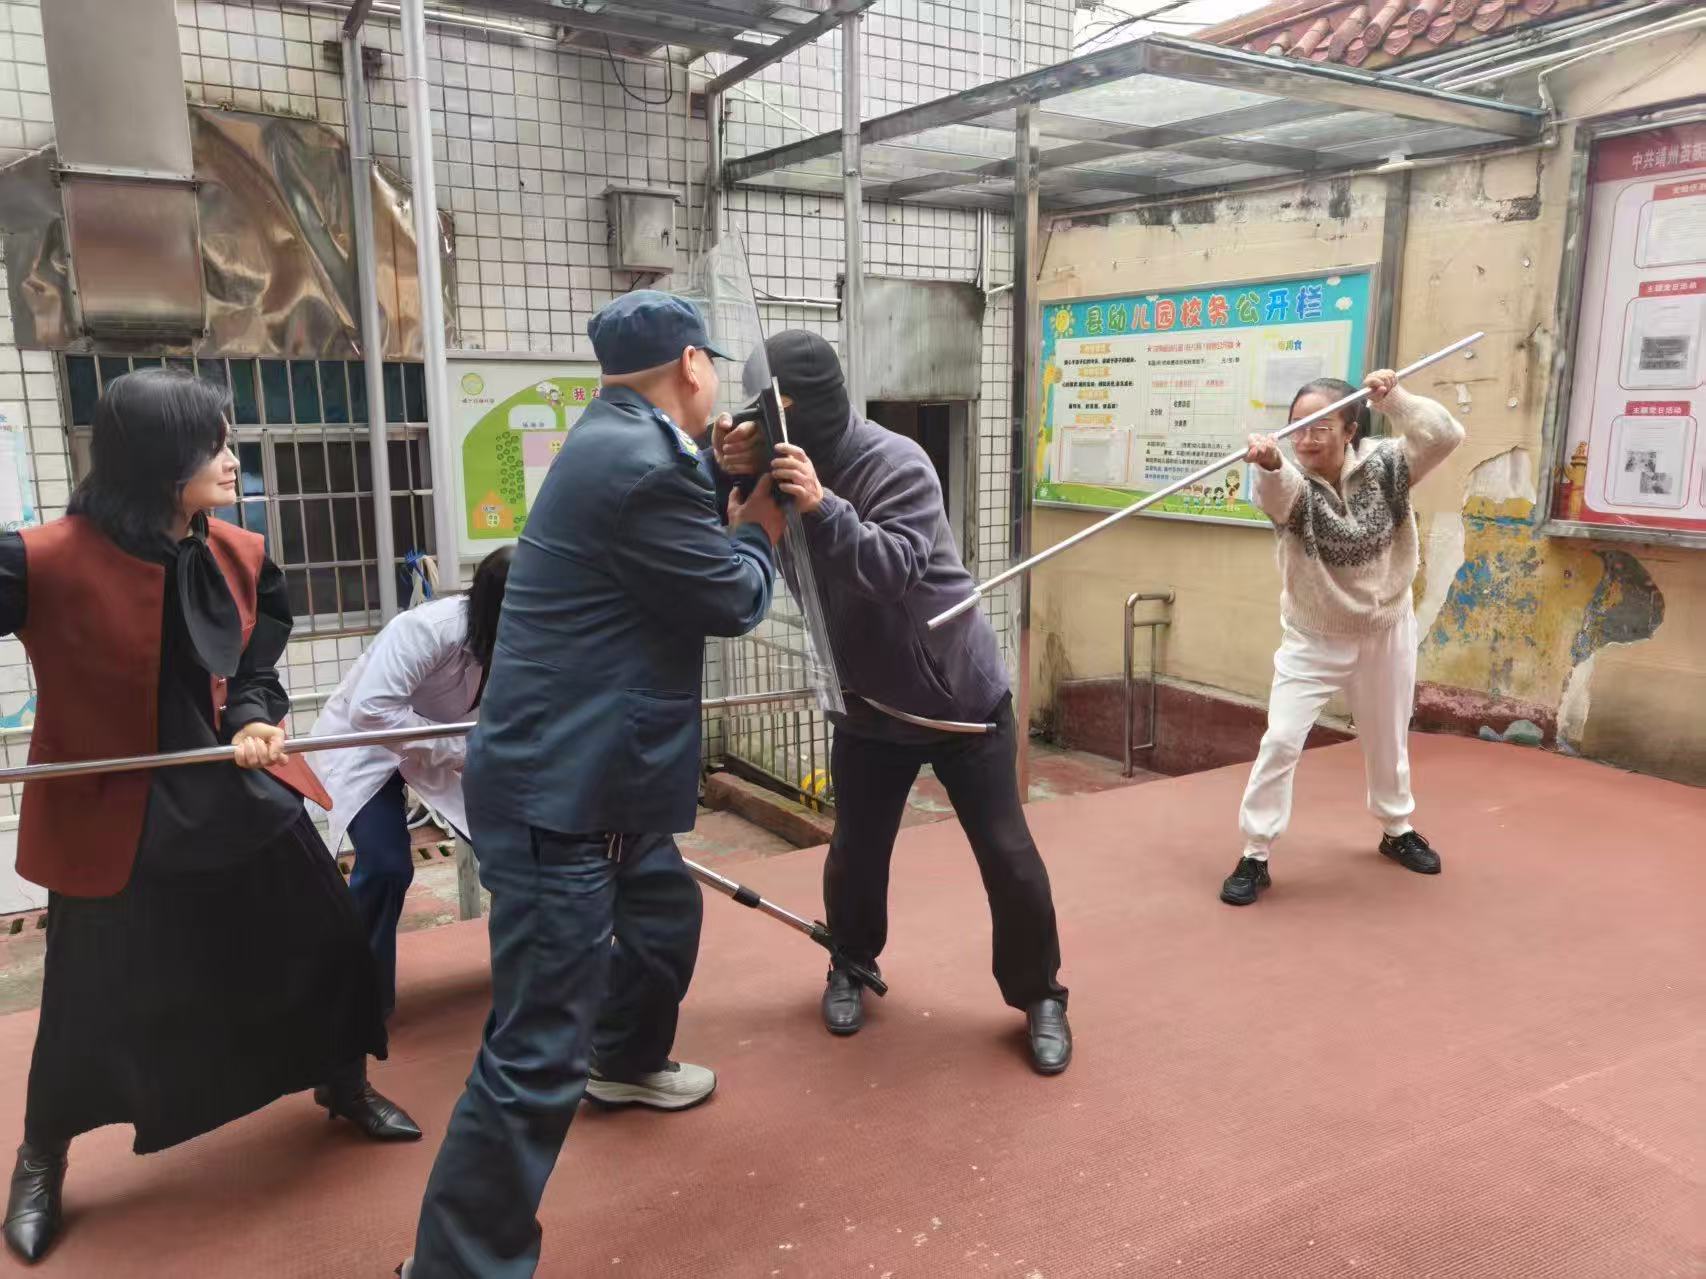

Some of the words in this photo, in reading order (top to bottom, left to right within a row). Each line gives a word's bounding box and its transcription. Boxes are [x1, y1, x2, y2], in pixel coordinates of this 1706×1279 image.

[1085, 284, 1323, 335] 县幼儿园校务公开栏
